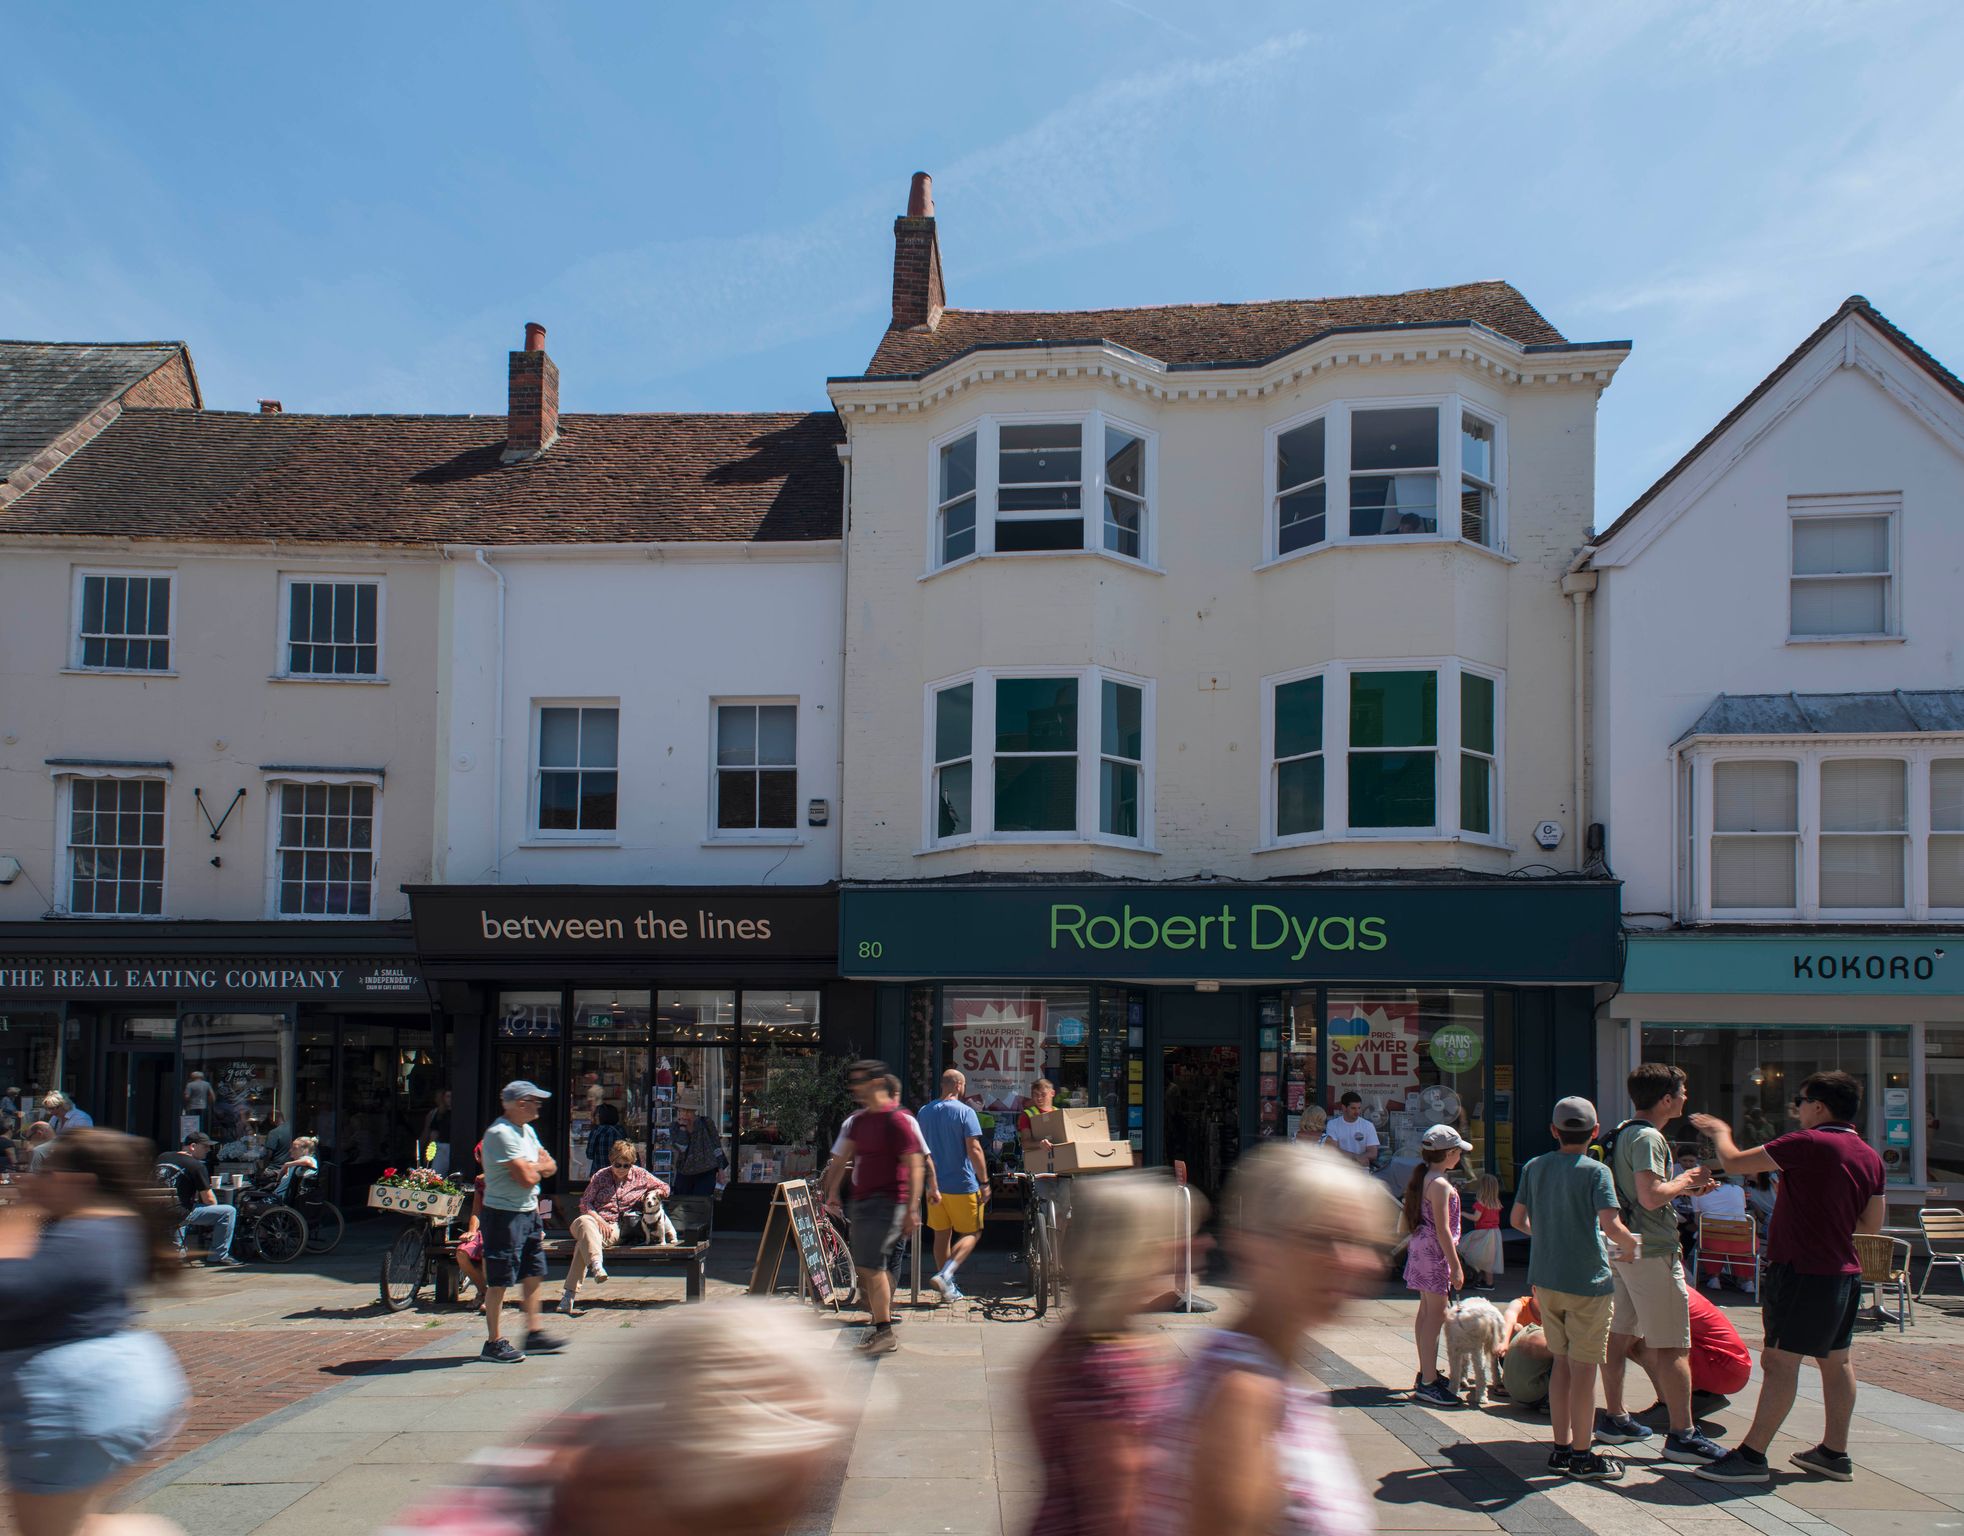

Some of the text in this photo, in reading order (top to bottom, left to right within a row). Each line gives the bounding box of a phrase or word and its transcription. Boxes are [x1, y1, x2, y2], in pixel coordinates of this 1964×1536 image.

[481, 910, 772, 939] between the lines
[1050, 903, 1388, 961] Robert Dyas
[858, 940, 883, 959] 80
[1793, 955, 1934, 980] KOKORO
[0, 969, 344, 989] THE REAL EATING COMPANY
[365, 976, 413, 984] INDEPENDENT
[963, 1036, 1035, 1049] SUMMER
[1371, 1031, 1397, 1039] PRICE
[1442, 1034, 1470, 1049] FANS
[1331, 1039, 1407, 1053] SMMER
[963, 1049, 1036, 1072] SALE
[1331, 1053, 1408, 1076] SALE
